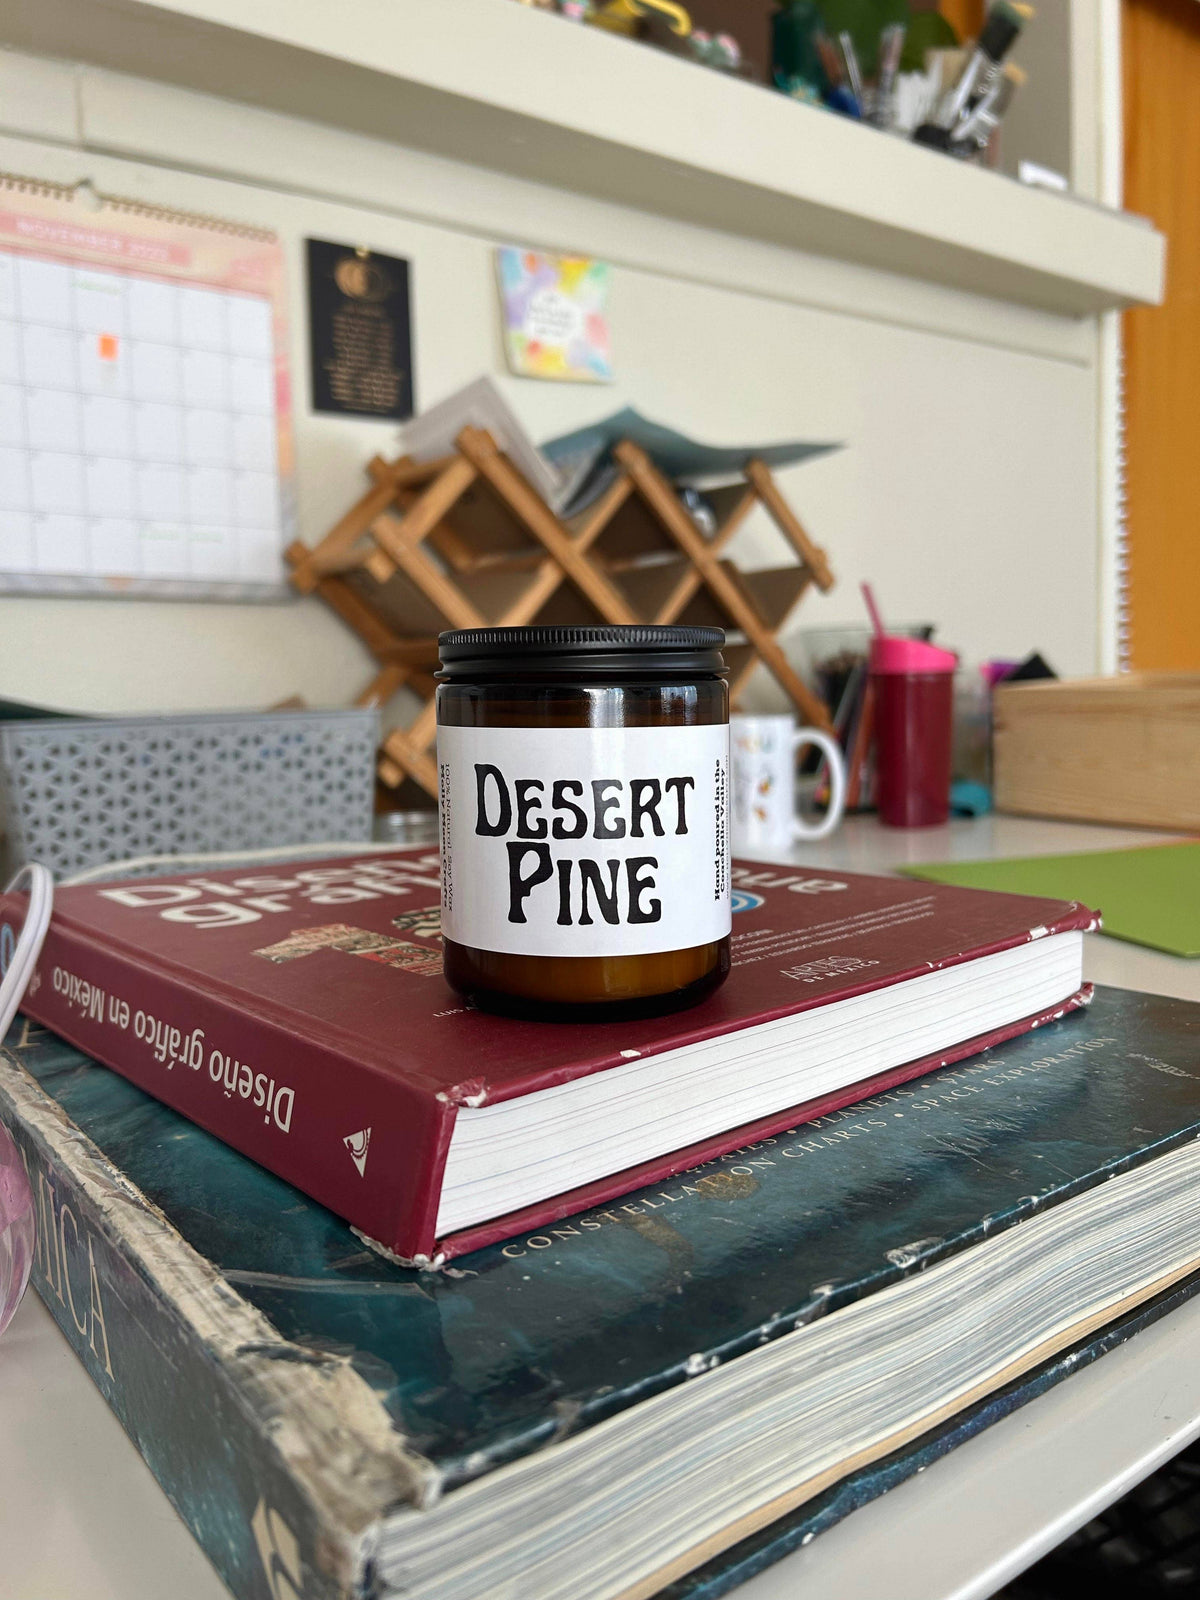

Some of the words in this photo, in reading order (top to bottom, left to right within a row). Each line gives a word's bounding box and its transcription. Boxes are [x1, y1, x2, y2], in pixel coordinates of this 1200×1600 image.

[473, 763, 695, 840] DESERT
[714, 802, 722, 856] poured
[506, 841, 662, 926] PINE
[53, 966, 105, 1023] México
[780, 956, 862, 980] ARTES
[802, 975, 824, 983] DE
[109, 994, 130, 1029] en
[134, 1010, 205, 1070] gráfico
[433, 1009, 463, 1017] LUIS
[209, 1050, 295, 1133] Diseño
[806, 1089, 915, 1128] PLANETS
[937, 1058, 1005, 1085] STARS
[502, 1157, 777, 1258] CONSTELLATION
[781, 1118, 888, 1158] CHARTS
[911, 1085, 984, 1112] SPACE
[983, 1036, 1118, 1086] EXPLORATION
